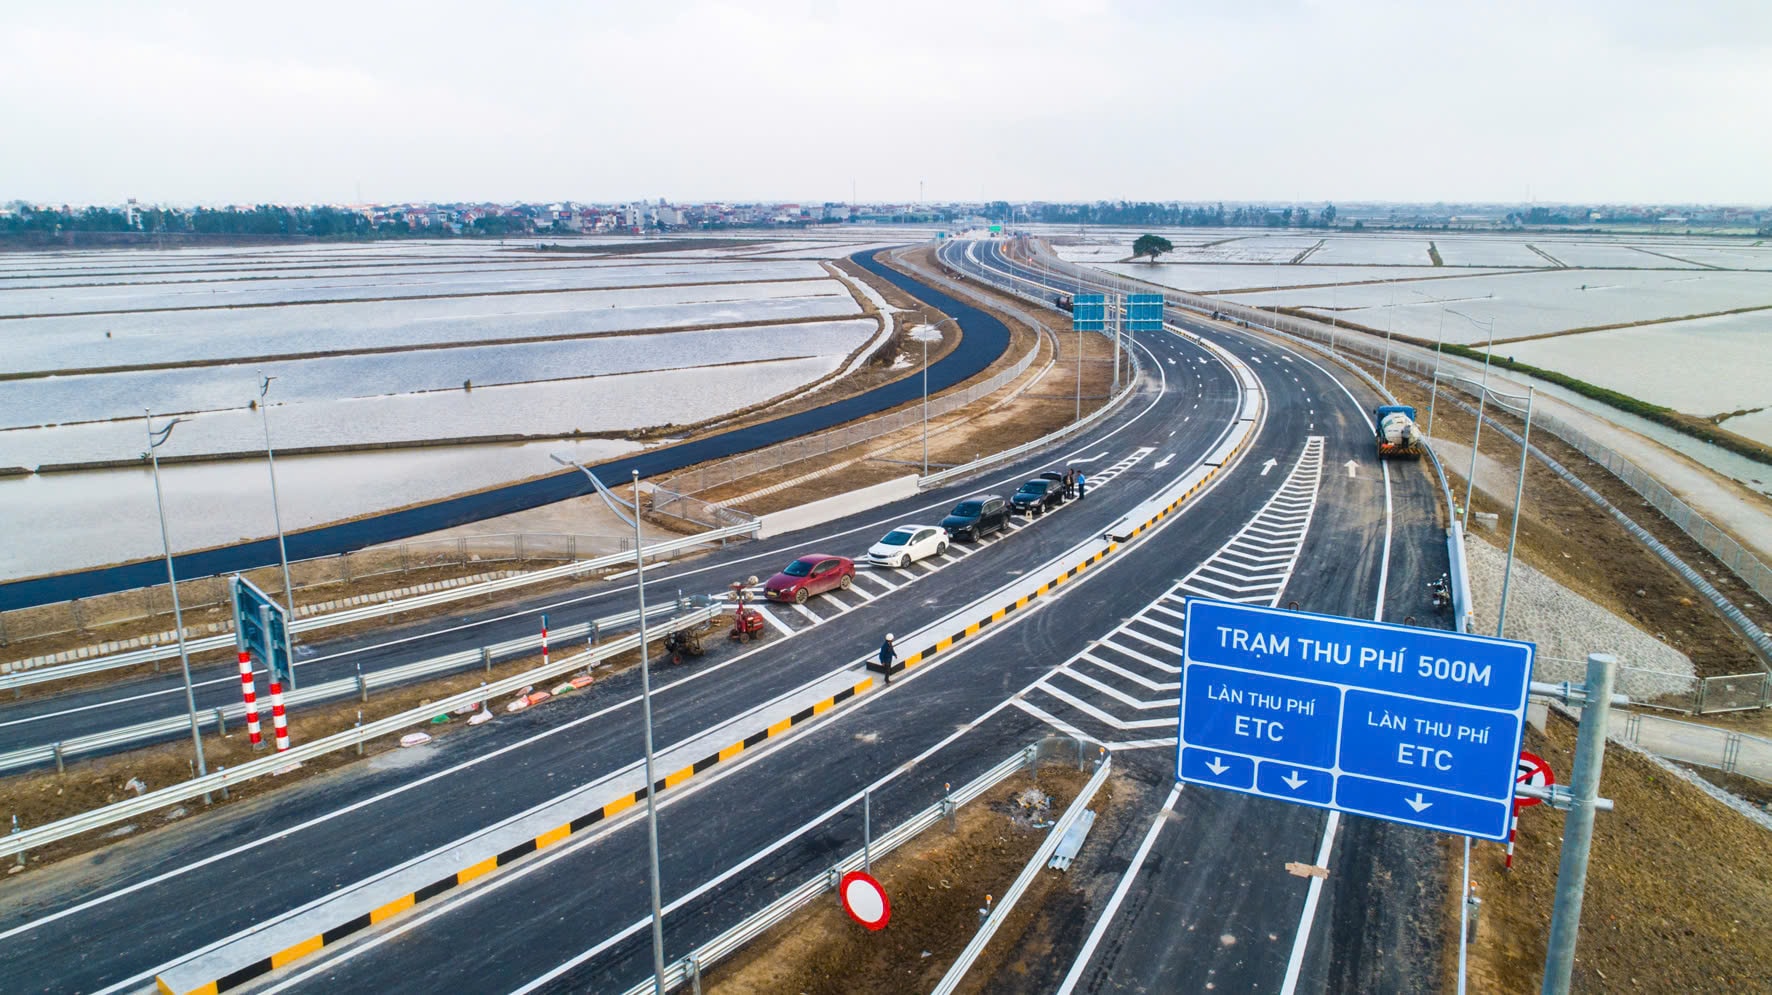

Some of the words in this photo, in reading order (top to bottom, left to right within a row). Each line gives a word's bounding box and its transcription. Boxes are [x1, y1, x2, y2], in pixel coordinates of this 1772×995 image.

[1217, 626, 1290, 658] TRẠM
[1297, 638, 1351, 665] THU
[1360, 647, 1407, 673] PHÍ
[1419, 656, 1492, 687] 500M
[1208, 684, 1243, 704] LÀN
[1248, 692, 1282, 710] THU
[1287, 698, 1315, 716] PHÍ
[1235, 715, 1284, 742] ETC
[1368, 710, 1407, 731] LÀN
[1414, 719, 1452, 738] THU
[1458, 725, 1490, 744] PHÍ
[1398, 743, 1453, 771] ETC
